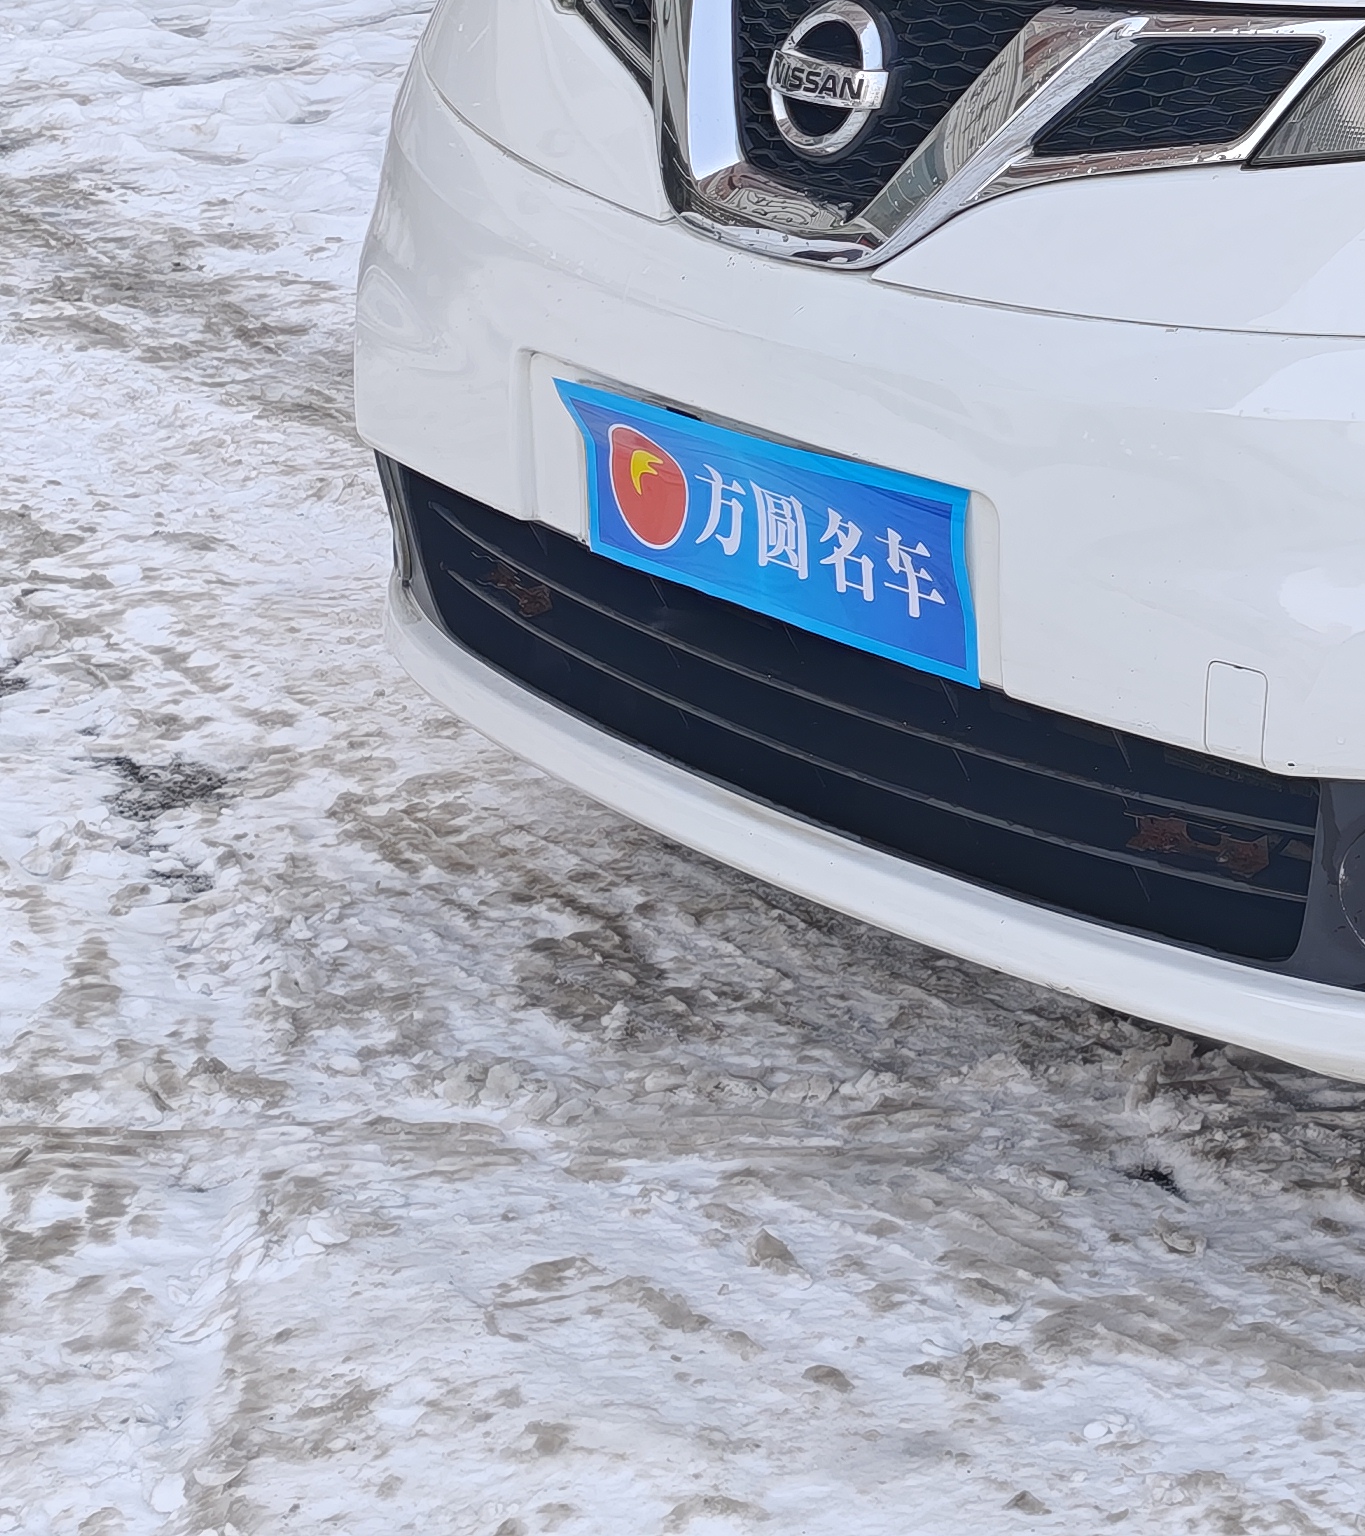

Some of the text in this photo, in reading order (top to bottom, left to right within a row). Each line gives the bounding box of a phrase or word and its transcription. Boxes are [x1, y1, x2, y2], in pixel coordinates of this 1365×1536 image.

[770, 54, 865, 100] NISSAN
[694, 463, 946, 618] 方圆名车
